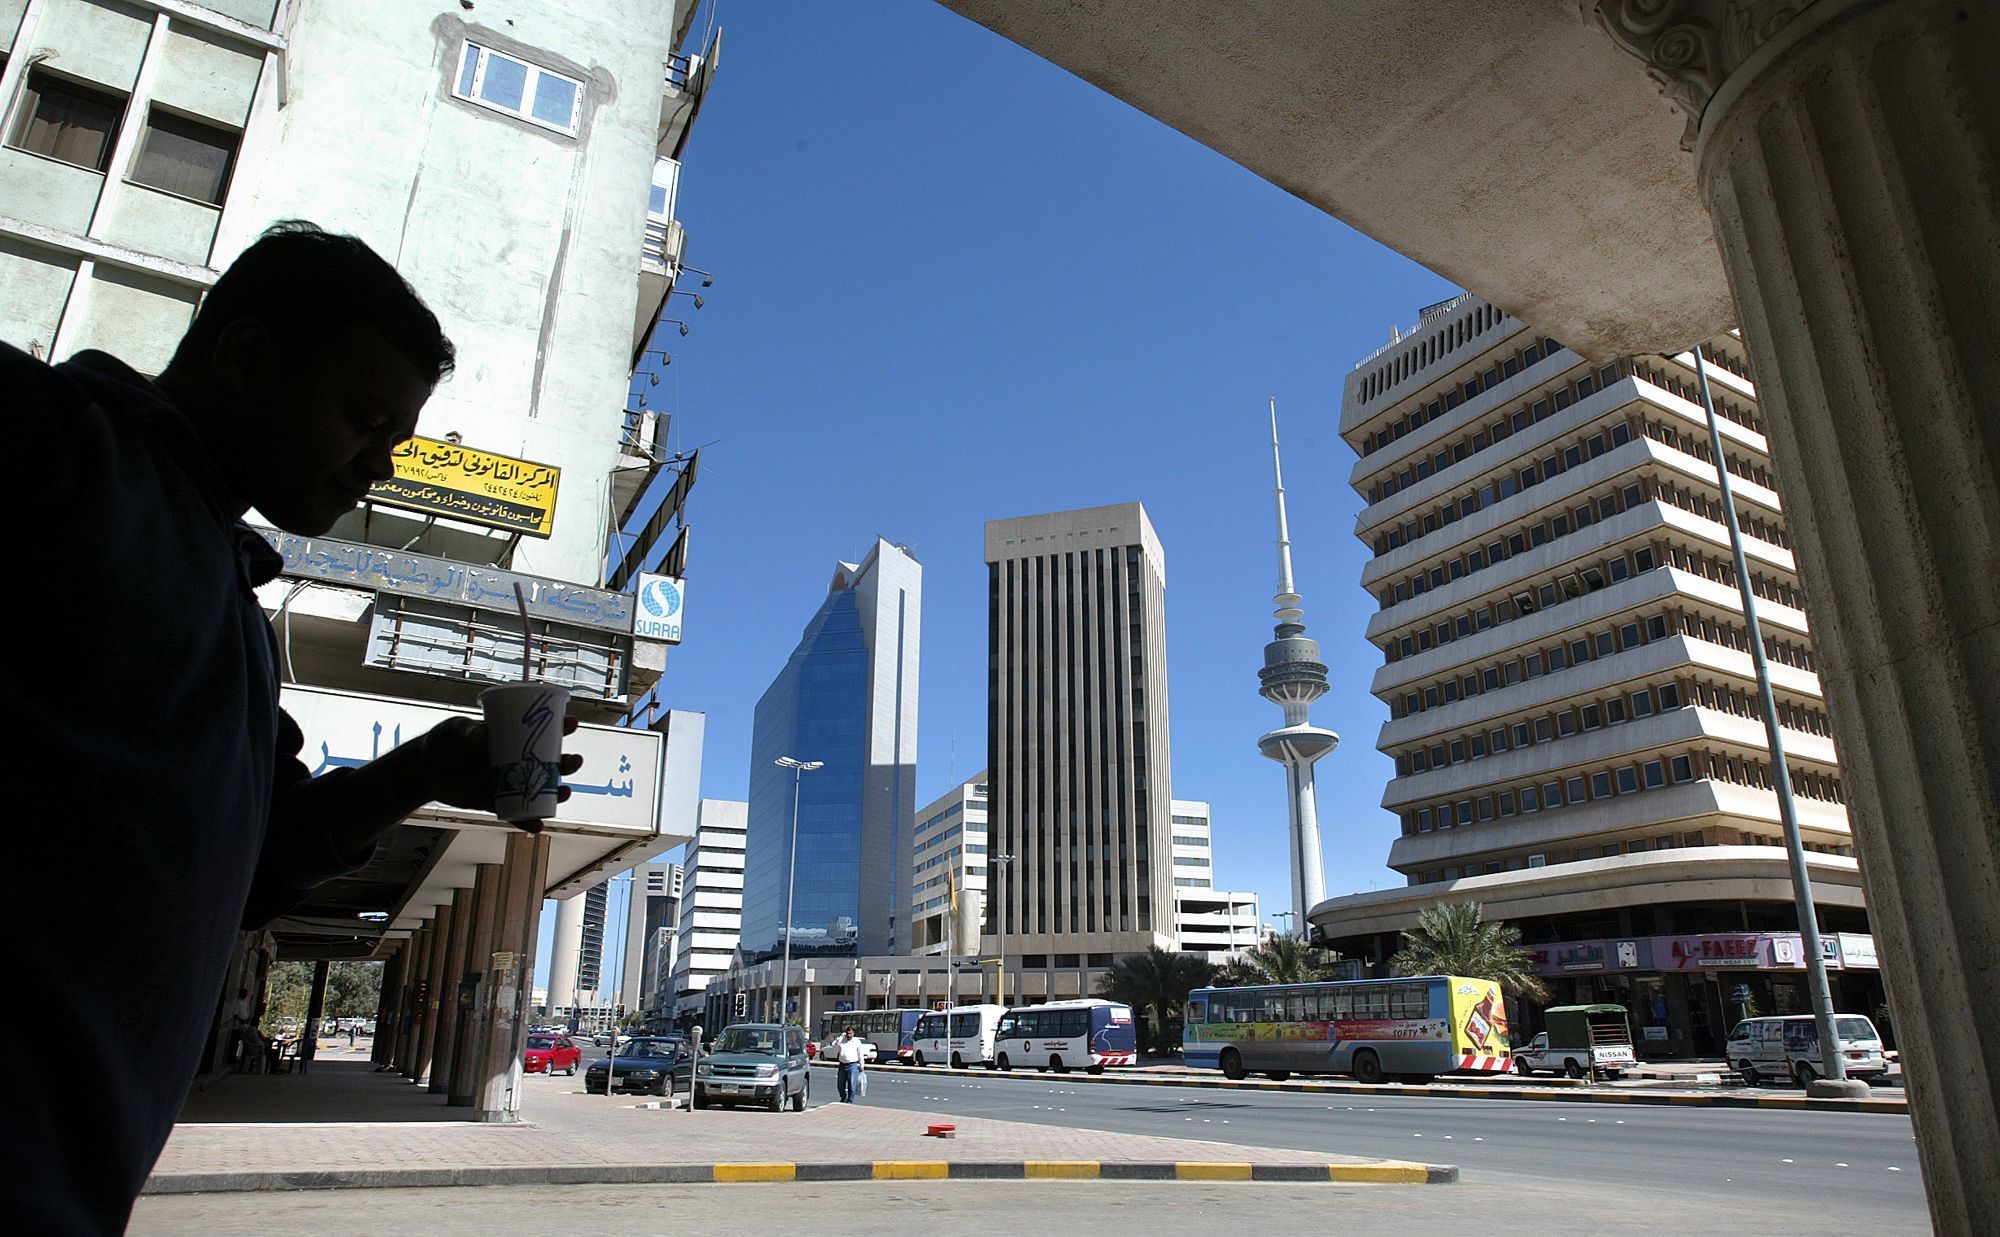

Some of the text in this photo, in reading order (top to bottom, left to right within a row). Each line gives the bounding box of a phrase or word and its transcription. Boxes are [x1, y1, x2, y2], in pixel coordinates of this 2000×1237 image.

[420, 445, 463, 469] لتدقيق
[463, 454, 519, 480] القانوني
[369, 480, 402, 493] معتمدو
[516, 467, 555, 488] المركز
[636, 619, 680, 639] SURRA
[1672, 939, 1759, 965] AL-FAEEZ
[1392, 1029, 1418, 1038] SOFTY
